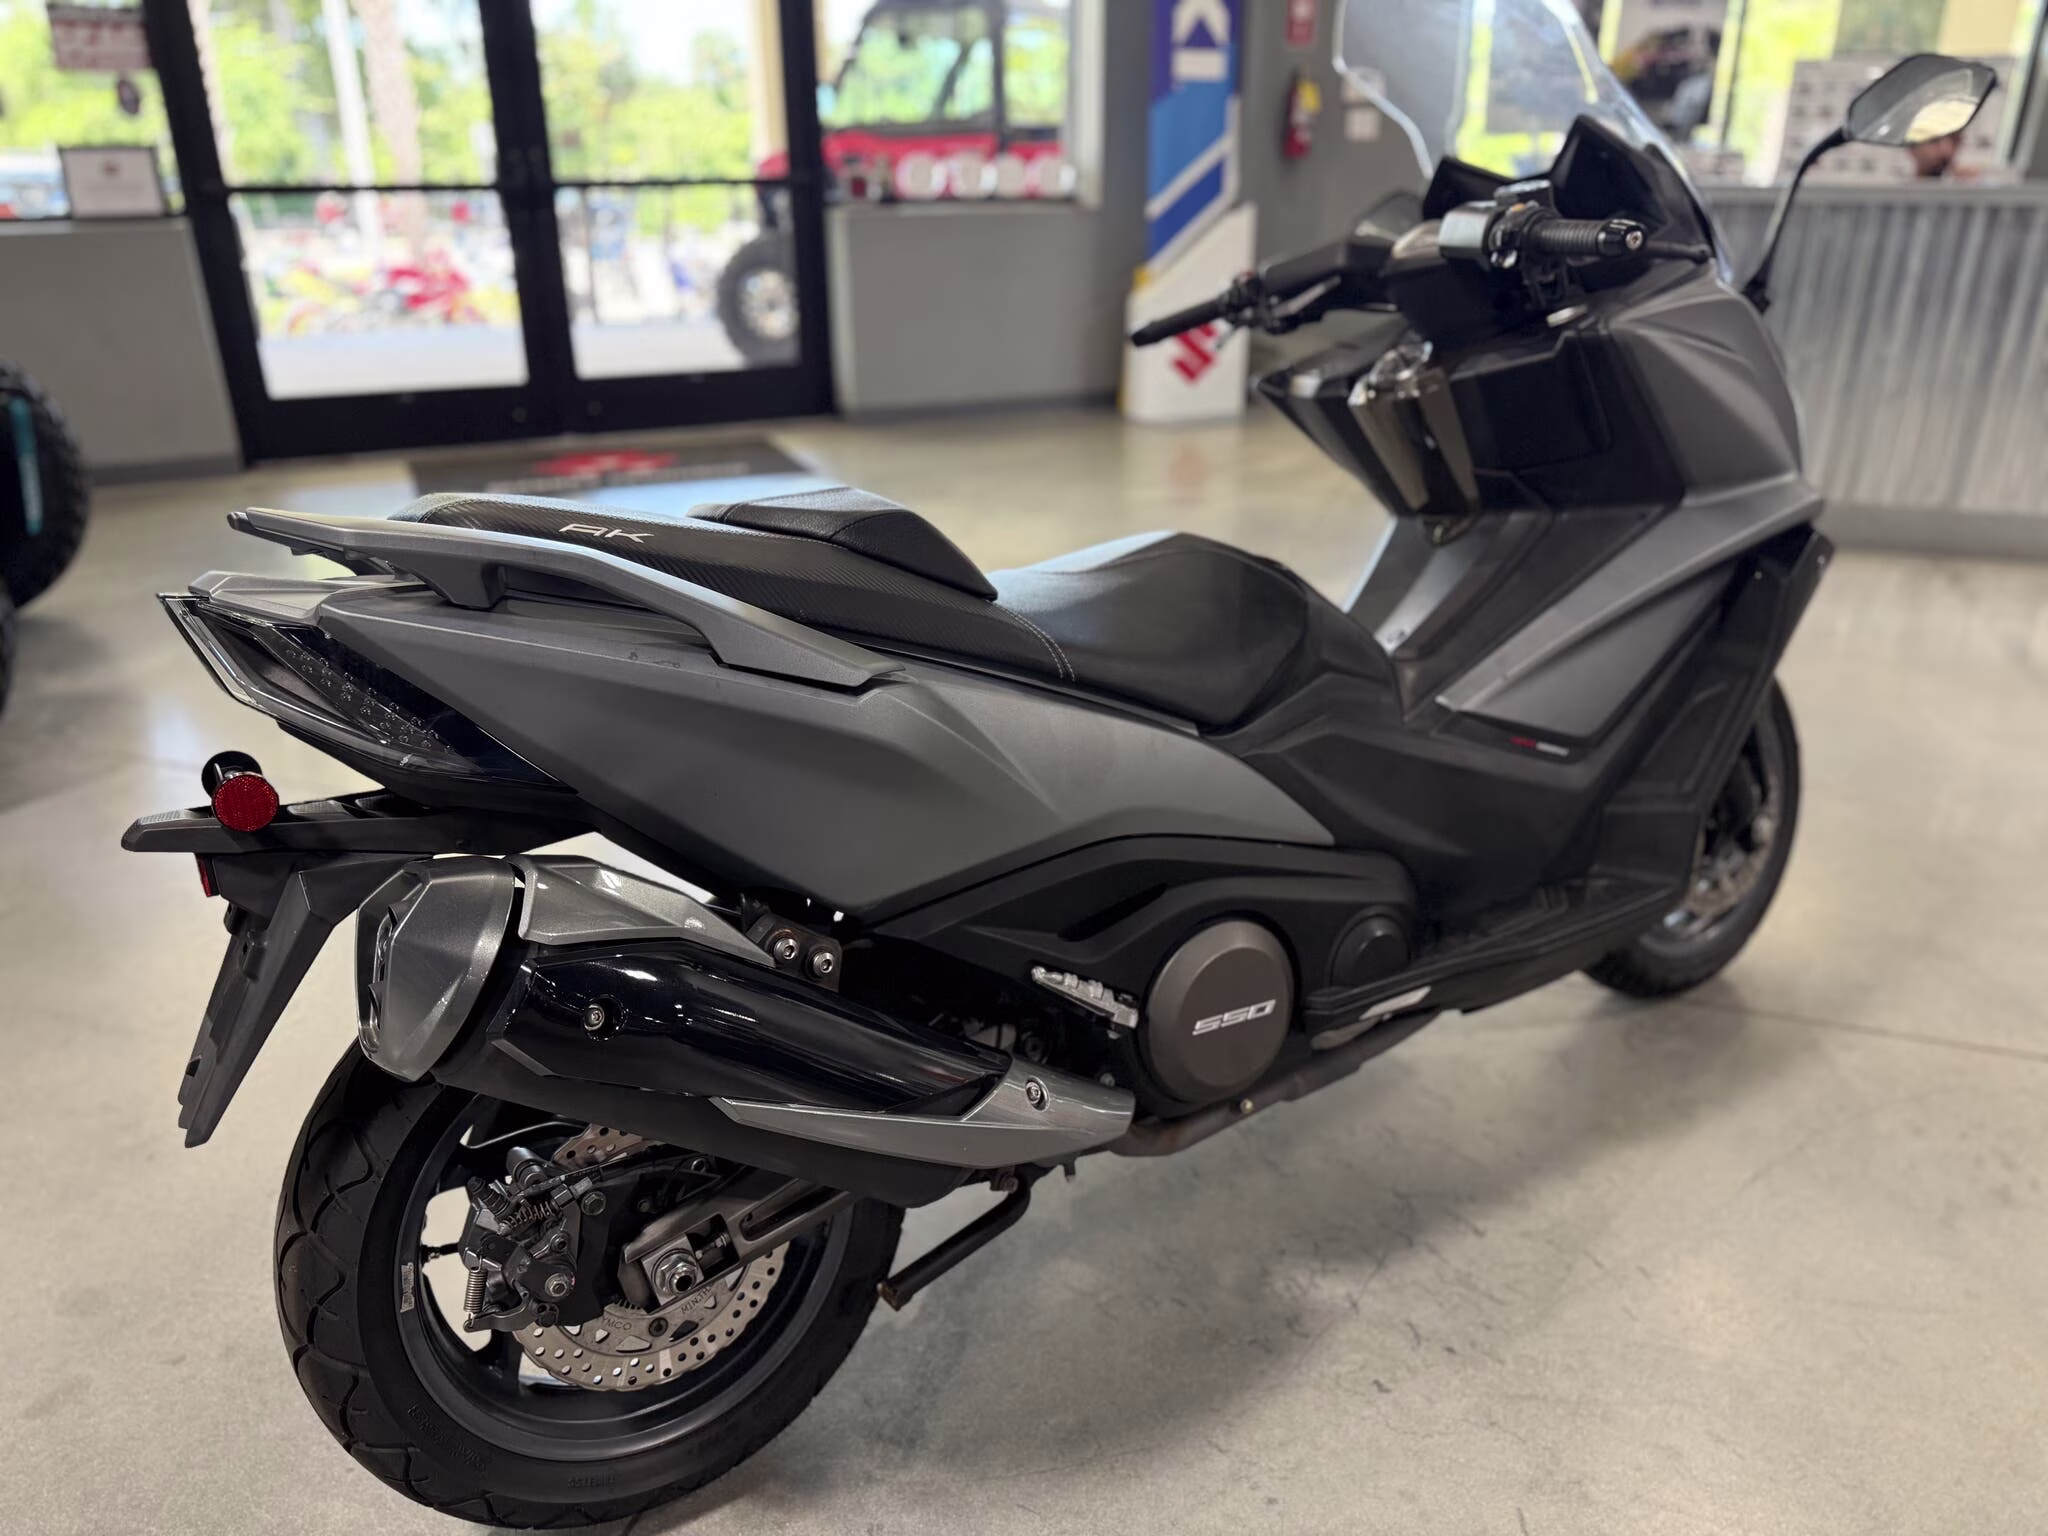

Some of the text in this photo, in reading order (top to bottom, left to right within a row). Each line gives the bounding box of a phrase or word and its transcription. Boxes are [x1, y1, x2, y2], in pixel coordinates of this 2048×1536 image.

[558, 523, 655, 544] AK
[1192, 999, 1276, 1036] 550
[602, 1317, 633, 1331] YMCO
